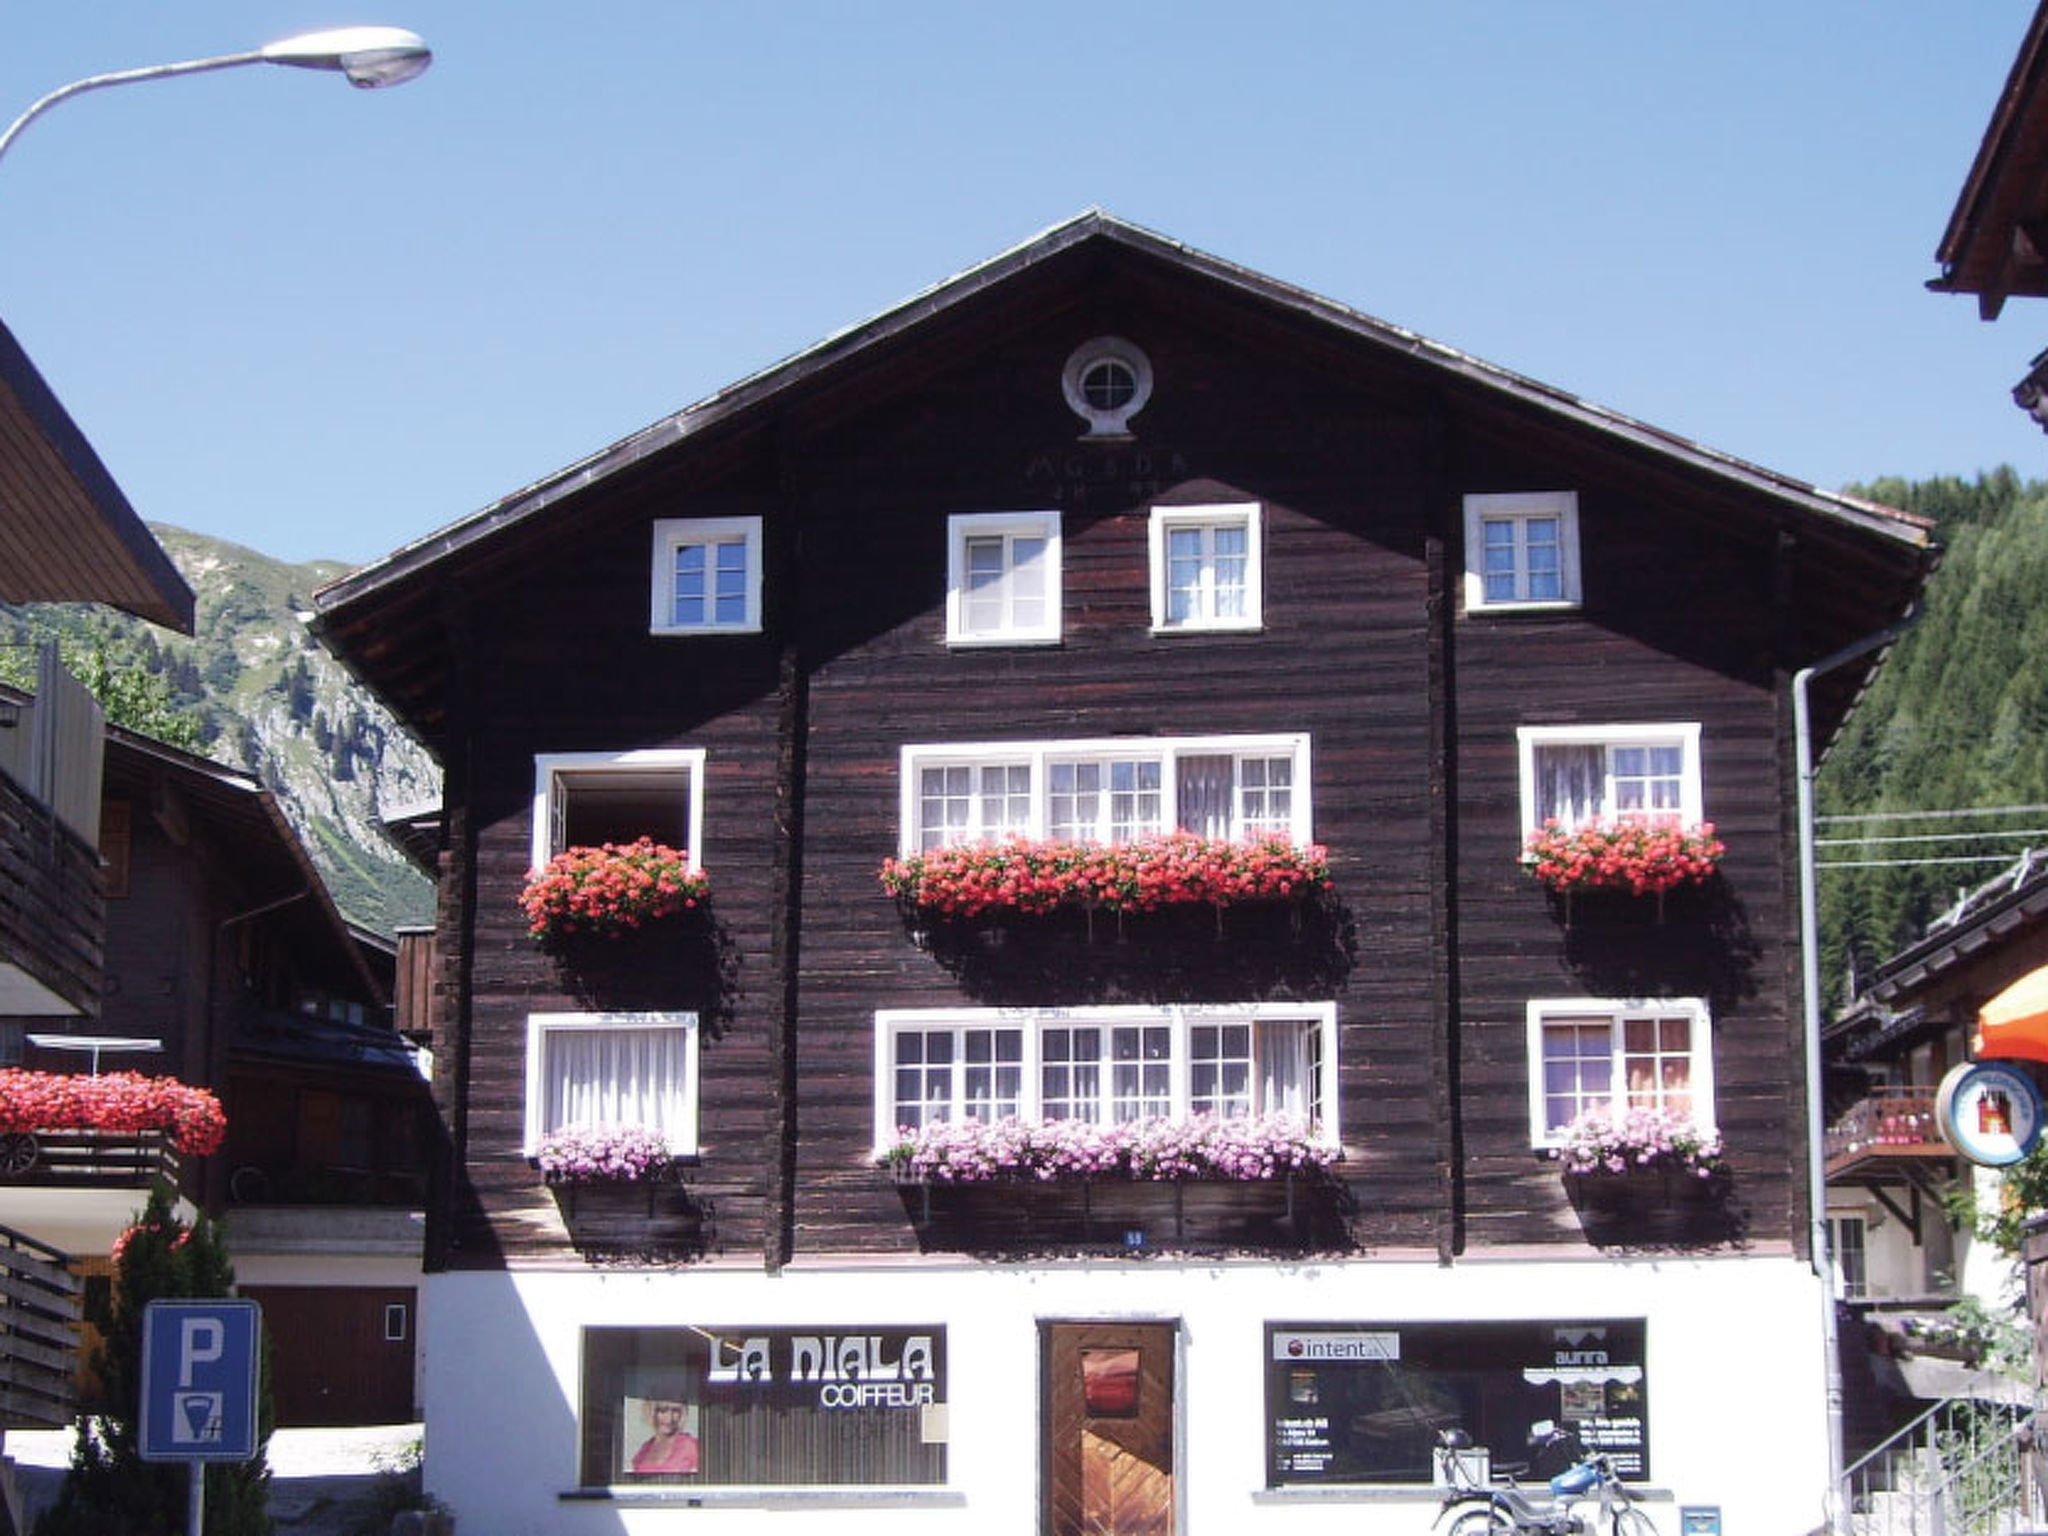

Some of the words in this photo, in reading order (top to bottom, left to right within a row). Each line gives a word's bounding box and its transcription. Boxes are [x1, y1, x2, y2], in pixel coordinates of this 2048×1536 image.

[180, 1317, 224, 1387] P
[708, 1336, 772, 1381] LA
[820, 1384, 934, 1407] COIFFEUR
